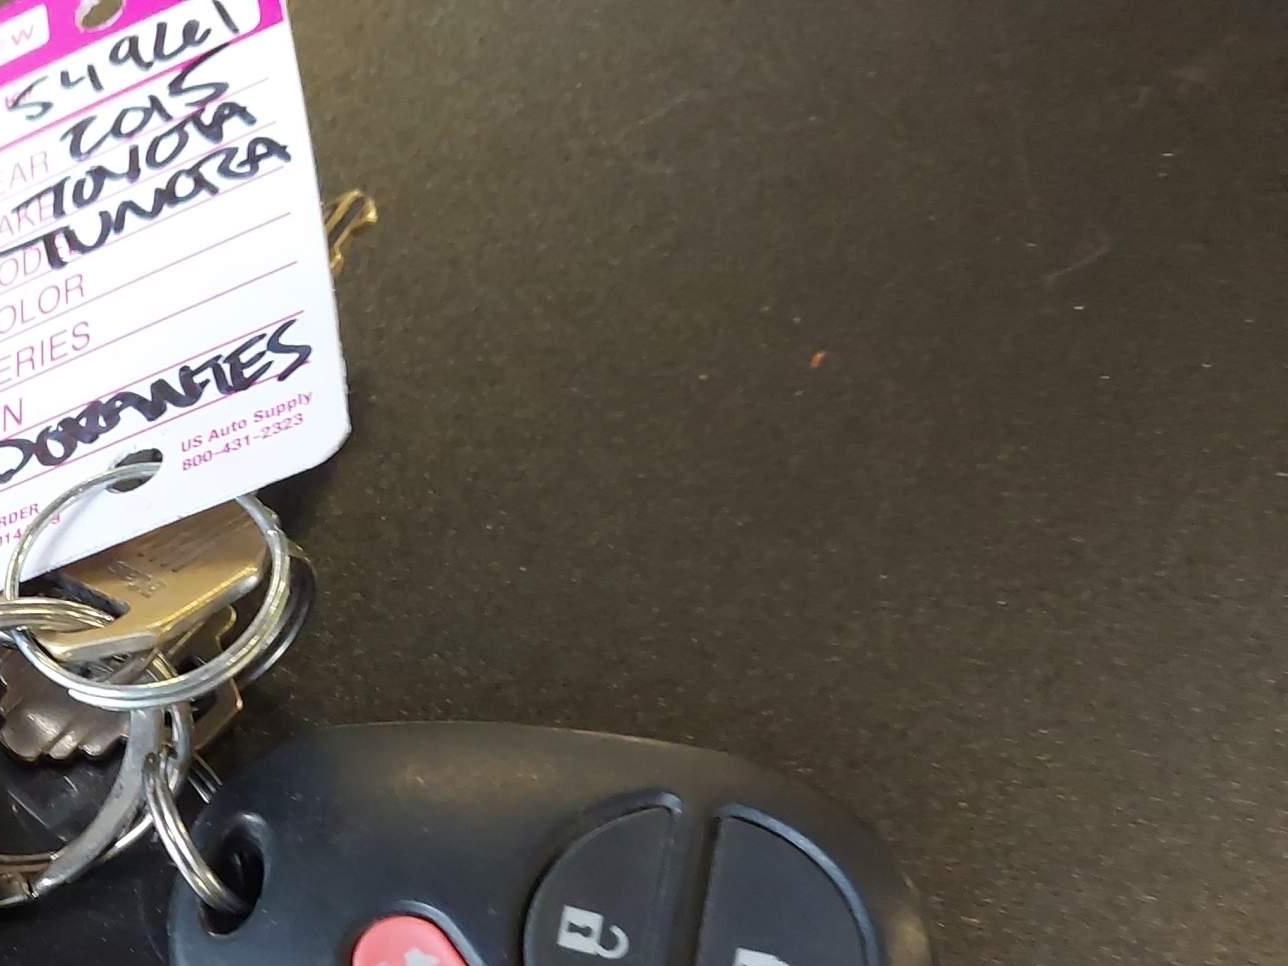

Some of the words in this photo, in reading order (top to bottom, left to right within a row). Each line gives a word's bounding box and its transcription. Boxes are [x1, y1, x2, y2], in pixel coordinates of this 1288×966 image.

[60, 41, 230, 161] 2015
[181, 435, 203, 452] US
[208, 418, 248, 442] Auto
[253, 391, 312, 423] Supply
[182, 412, 304, 471] 800-431-2323
